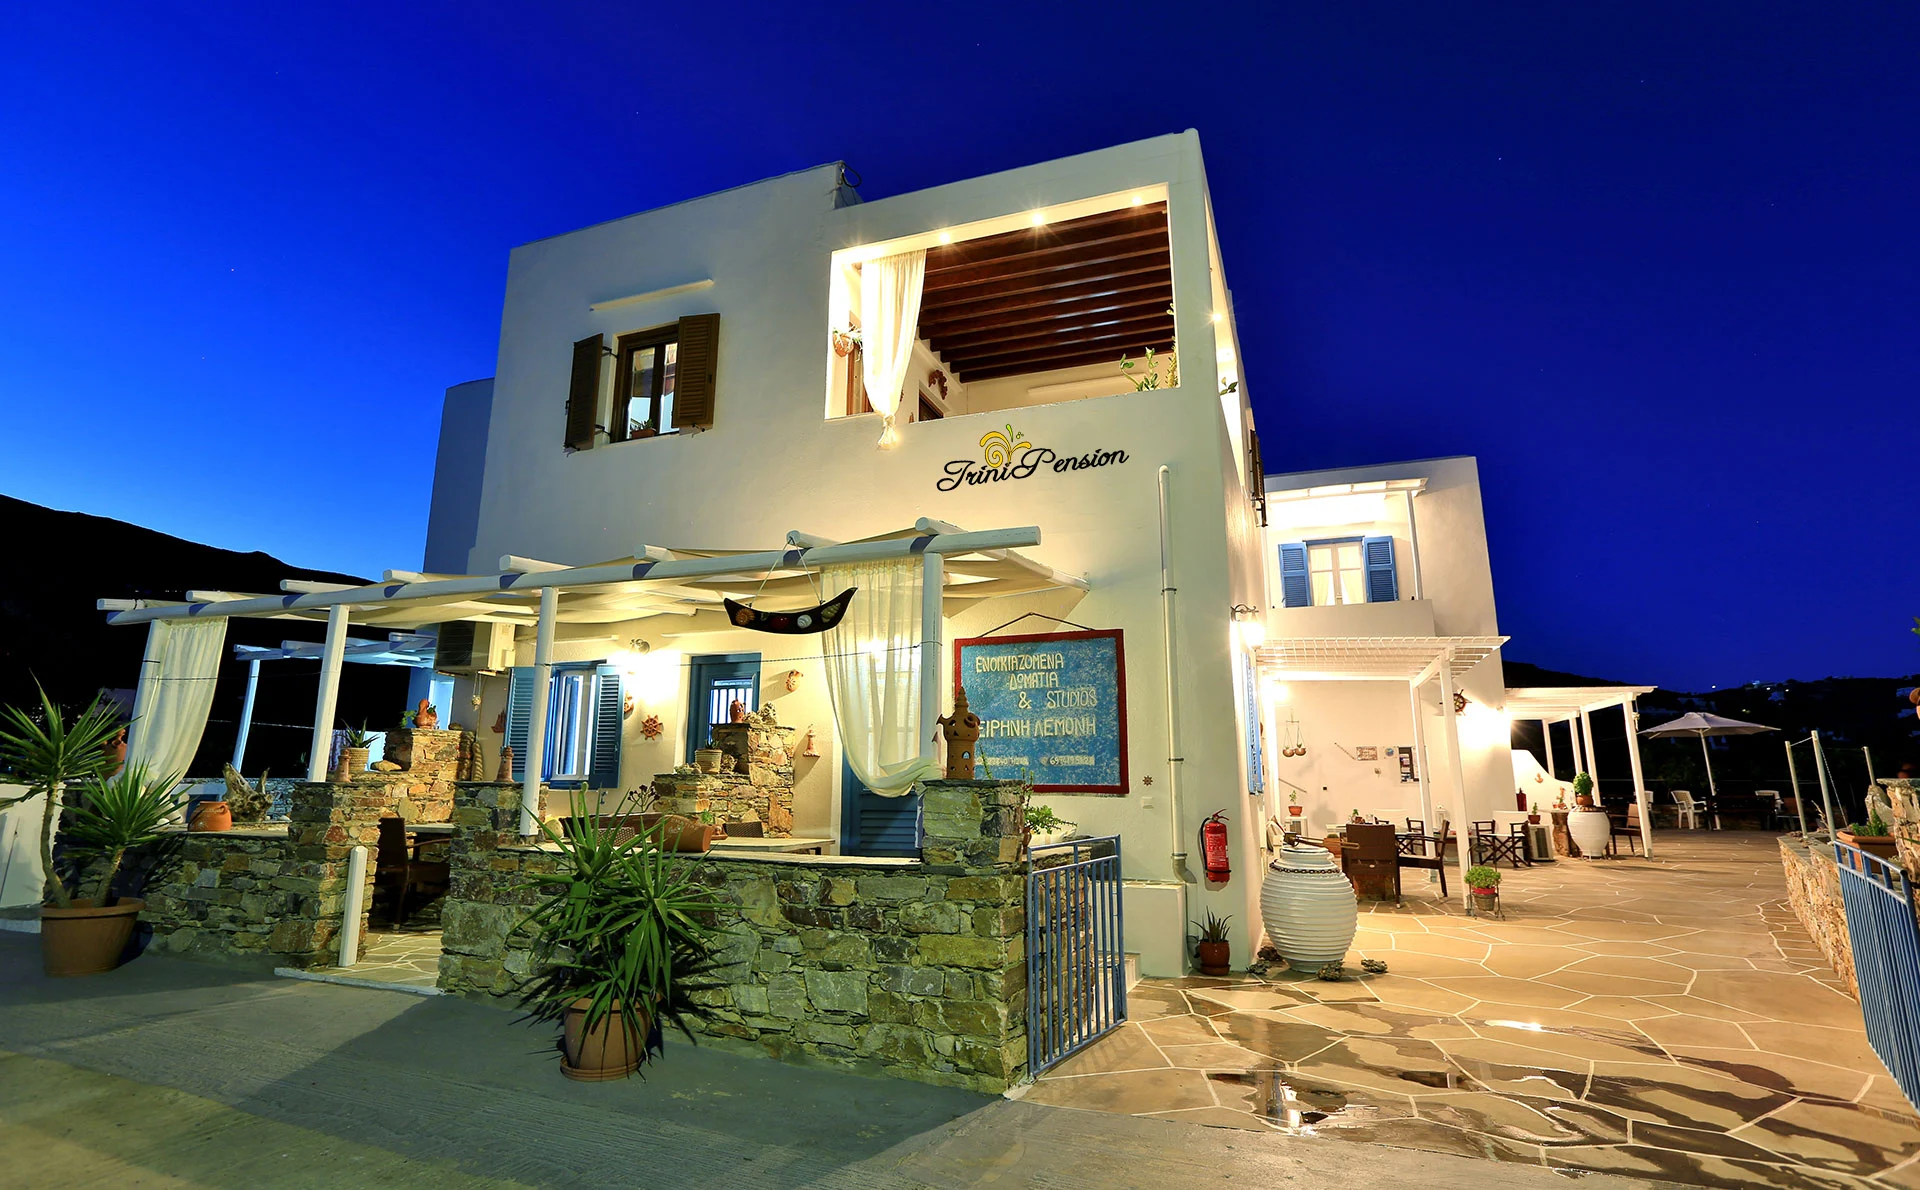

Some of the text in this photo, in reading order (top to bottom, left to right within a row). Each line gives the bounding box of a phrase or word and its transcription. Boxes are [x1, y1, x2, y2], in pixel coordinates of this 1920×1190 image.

[1012, 447, 1129, 480] Pension
[1018, 689, 1098, 709] & STUDIOS
